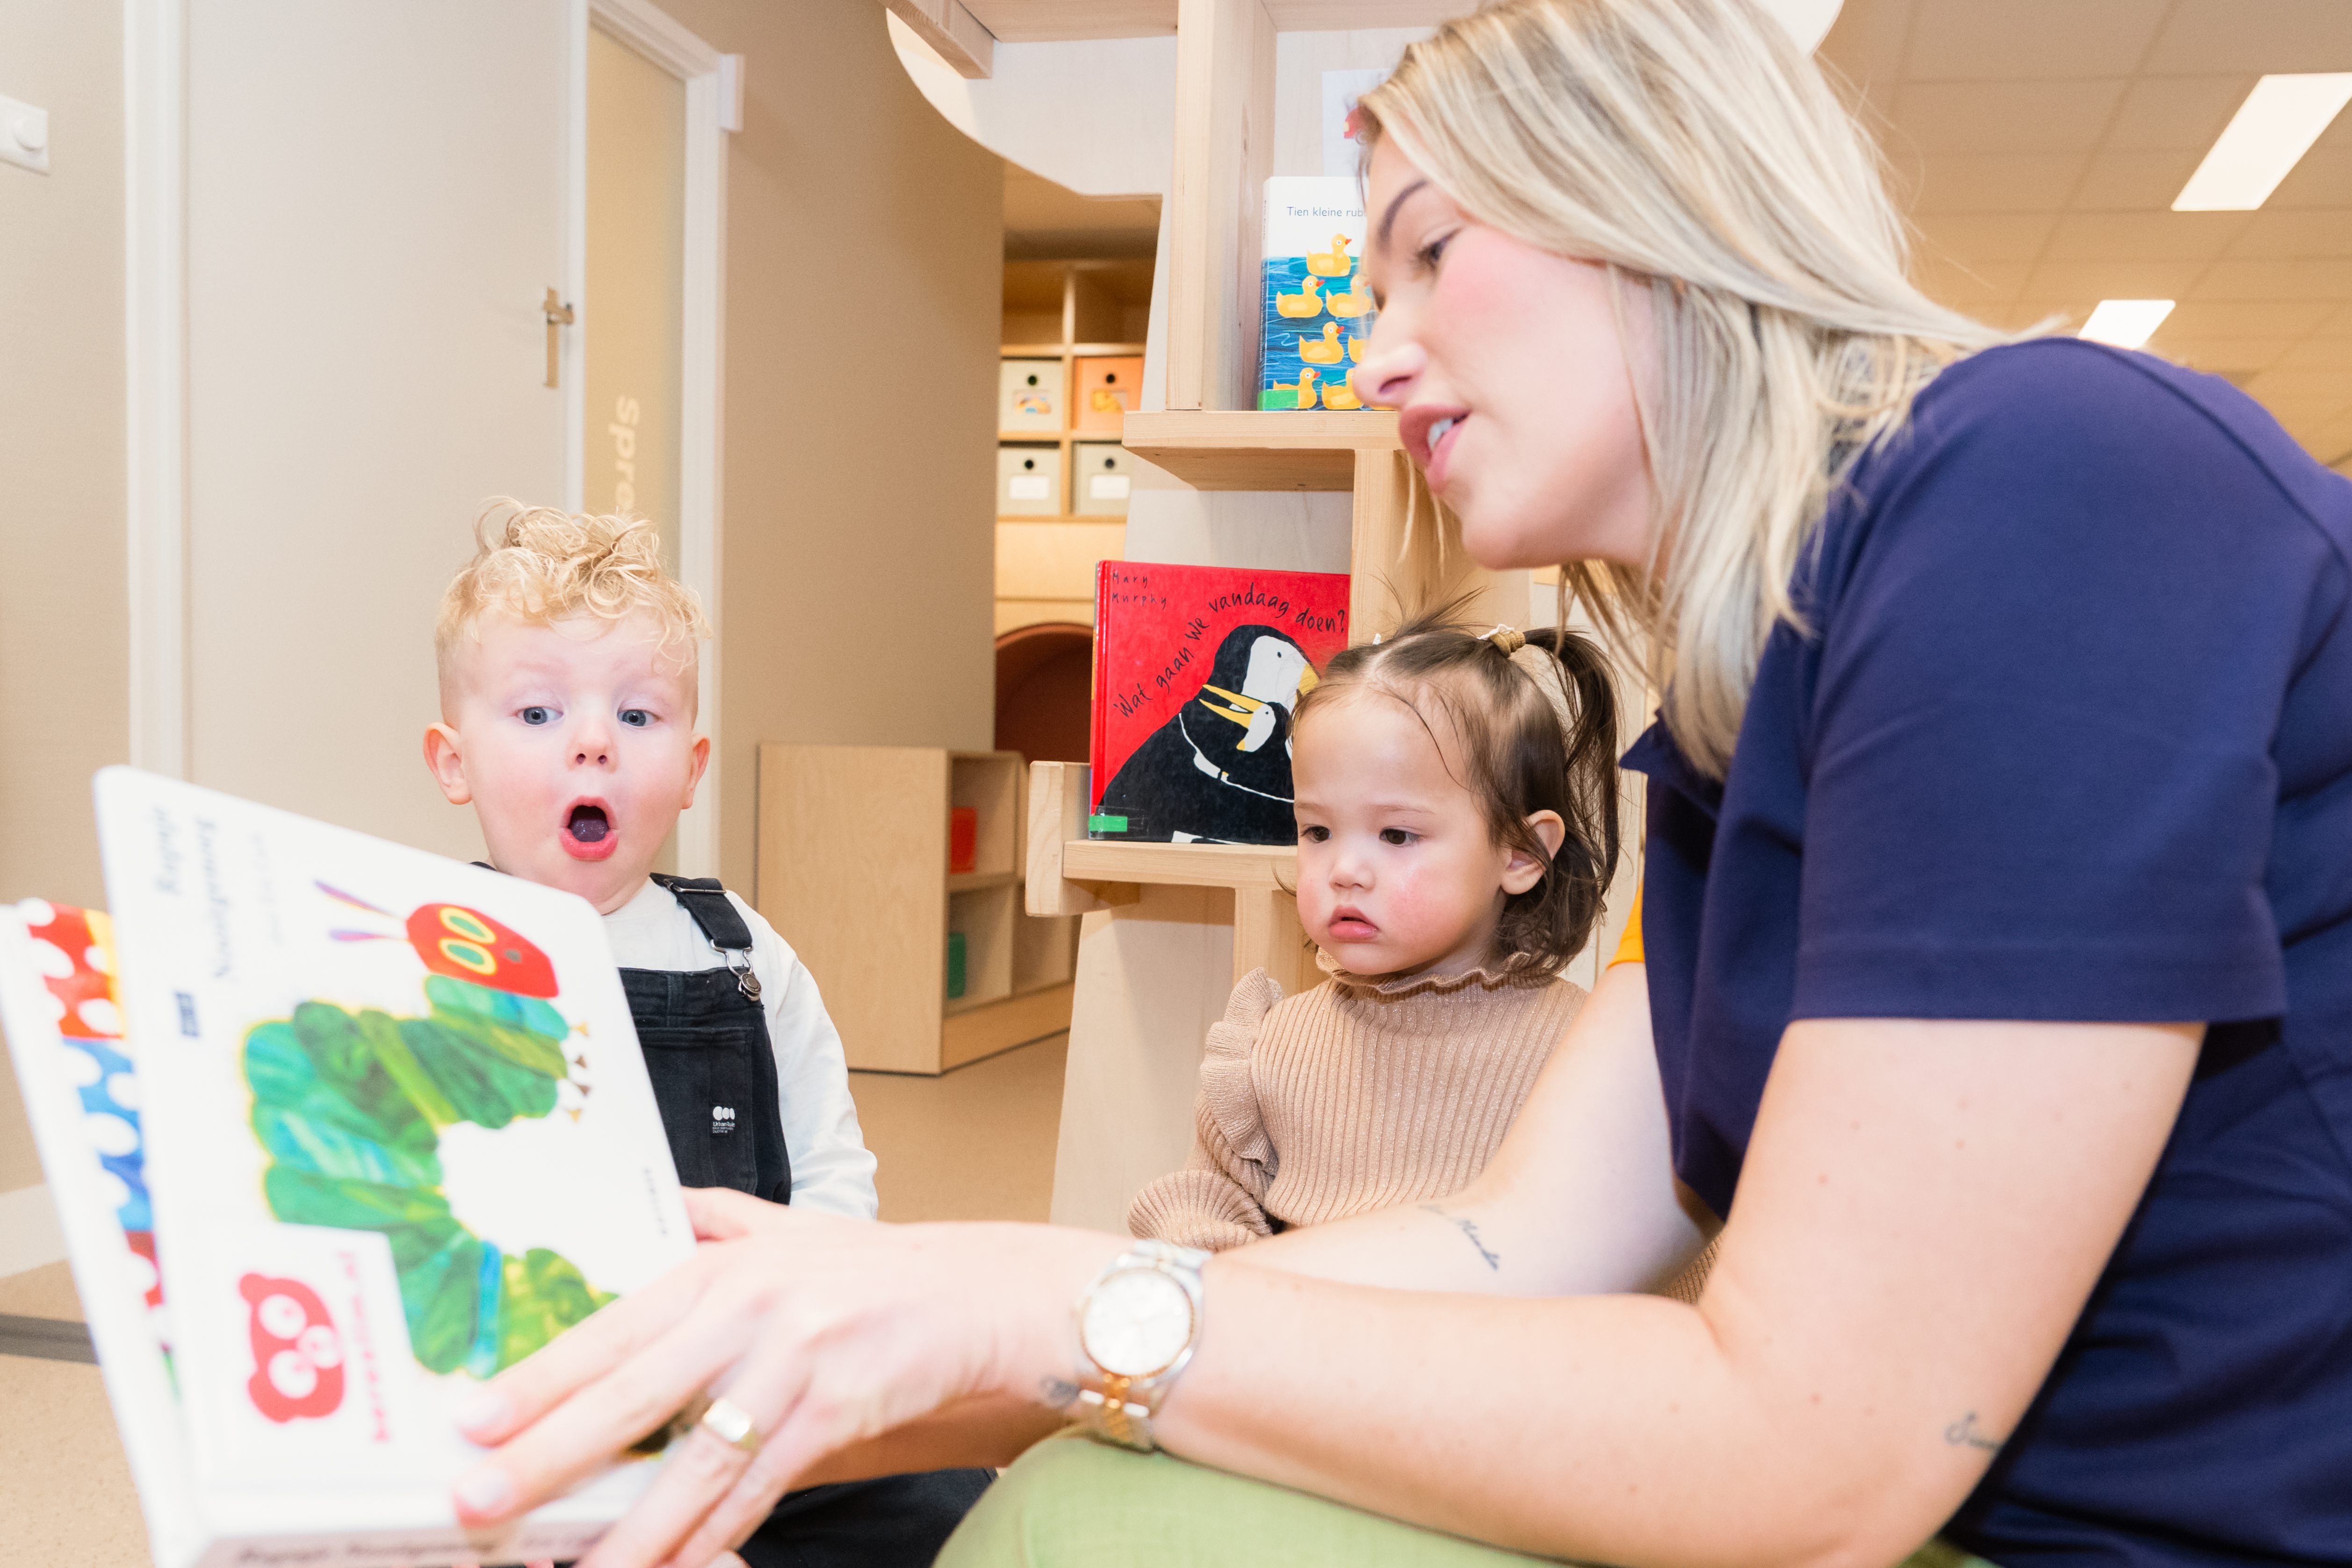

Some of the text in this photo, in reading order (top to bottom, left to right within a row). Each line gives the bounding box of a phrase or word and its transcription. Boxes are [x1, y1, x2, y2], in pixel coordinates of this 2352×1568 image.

[1287, 206, 1366, 217] Tien kleine rub
[1112, 572, 1147, 589] Mary
[1112, 592, 1166, 610] Murphy
[1113, 683, 1153, 718] Wat
[1156, 647, 1195, 694] gaan
[1208, 582, 1290, 618] vandaag
[1295, 607, 1345, 633] doen?
